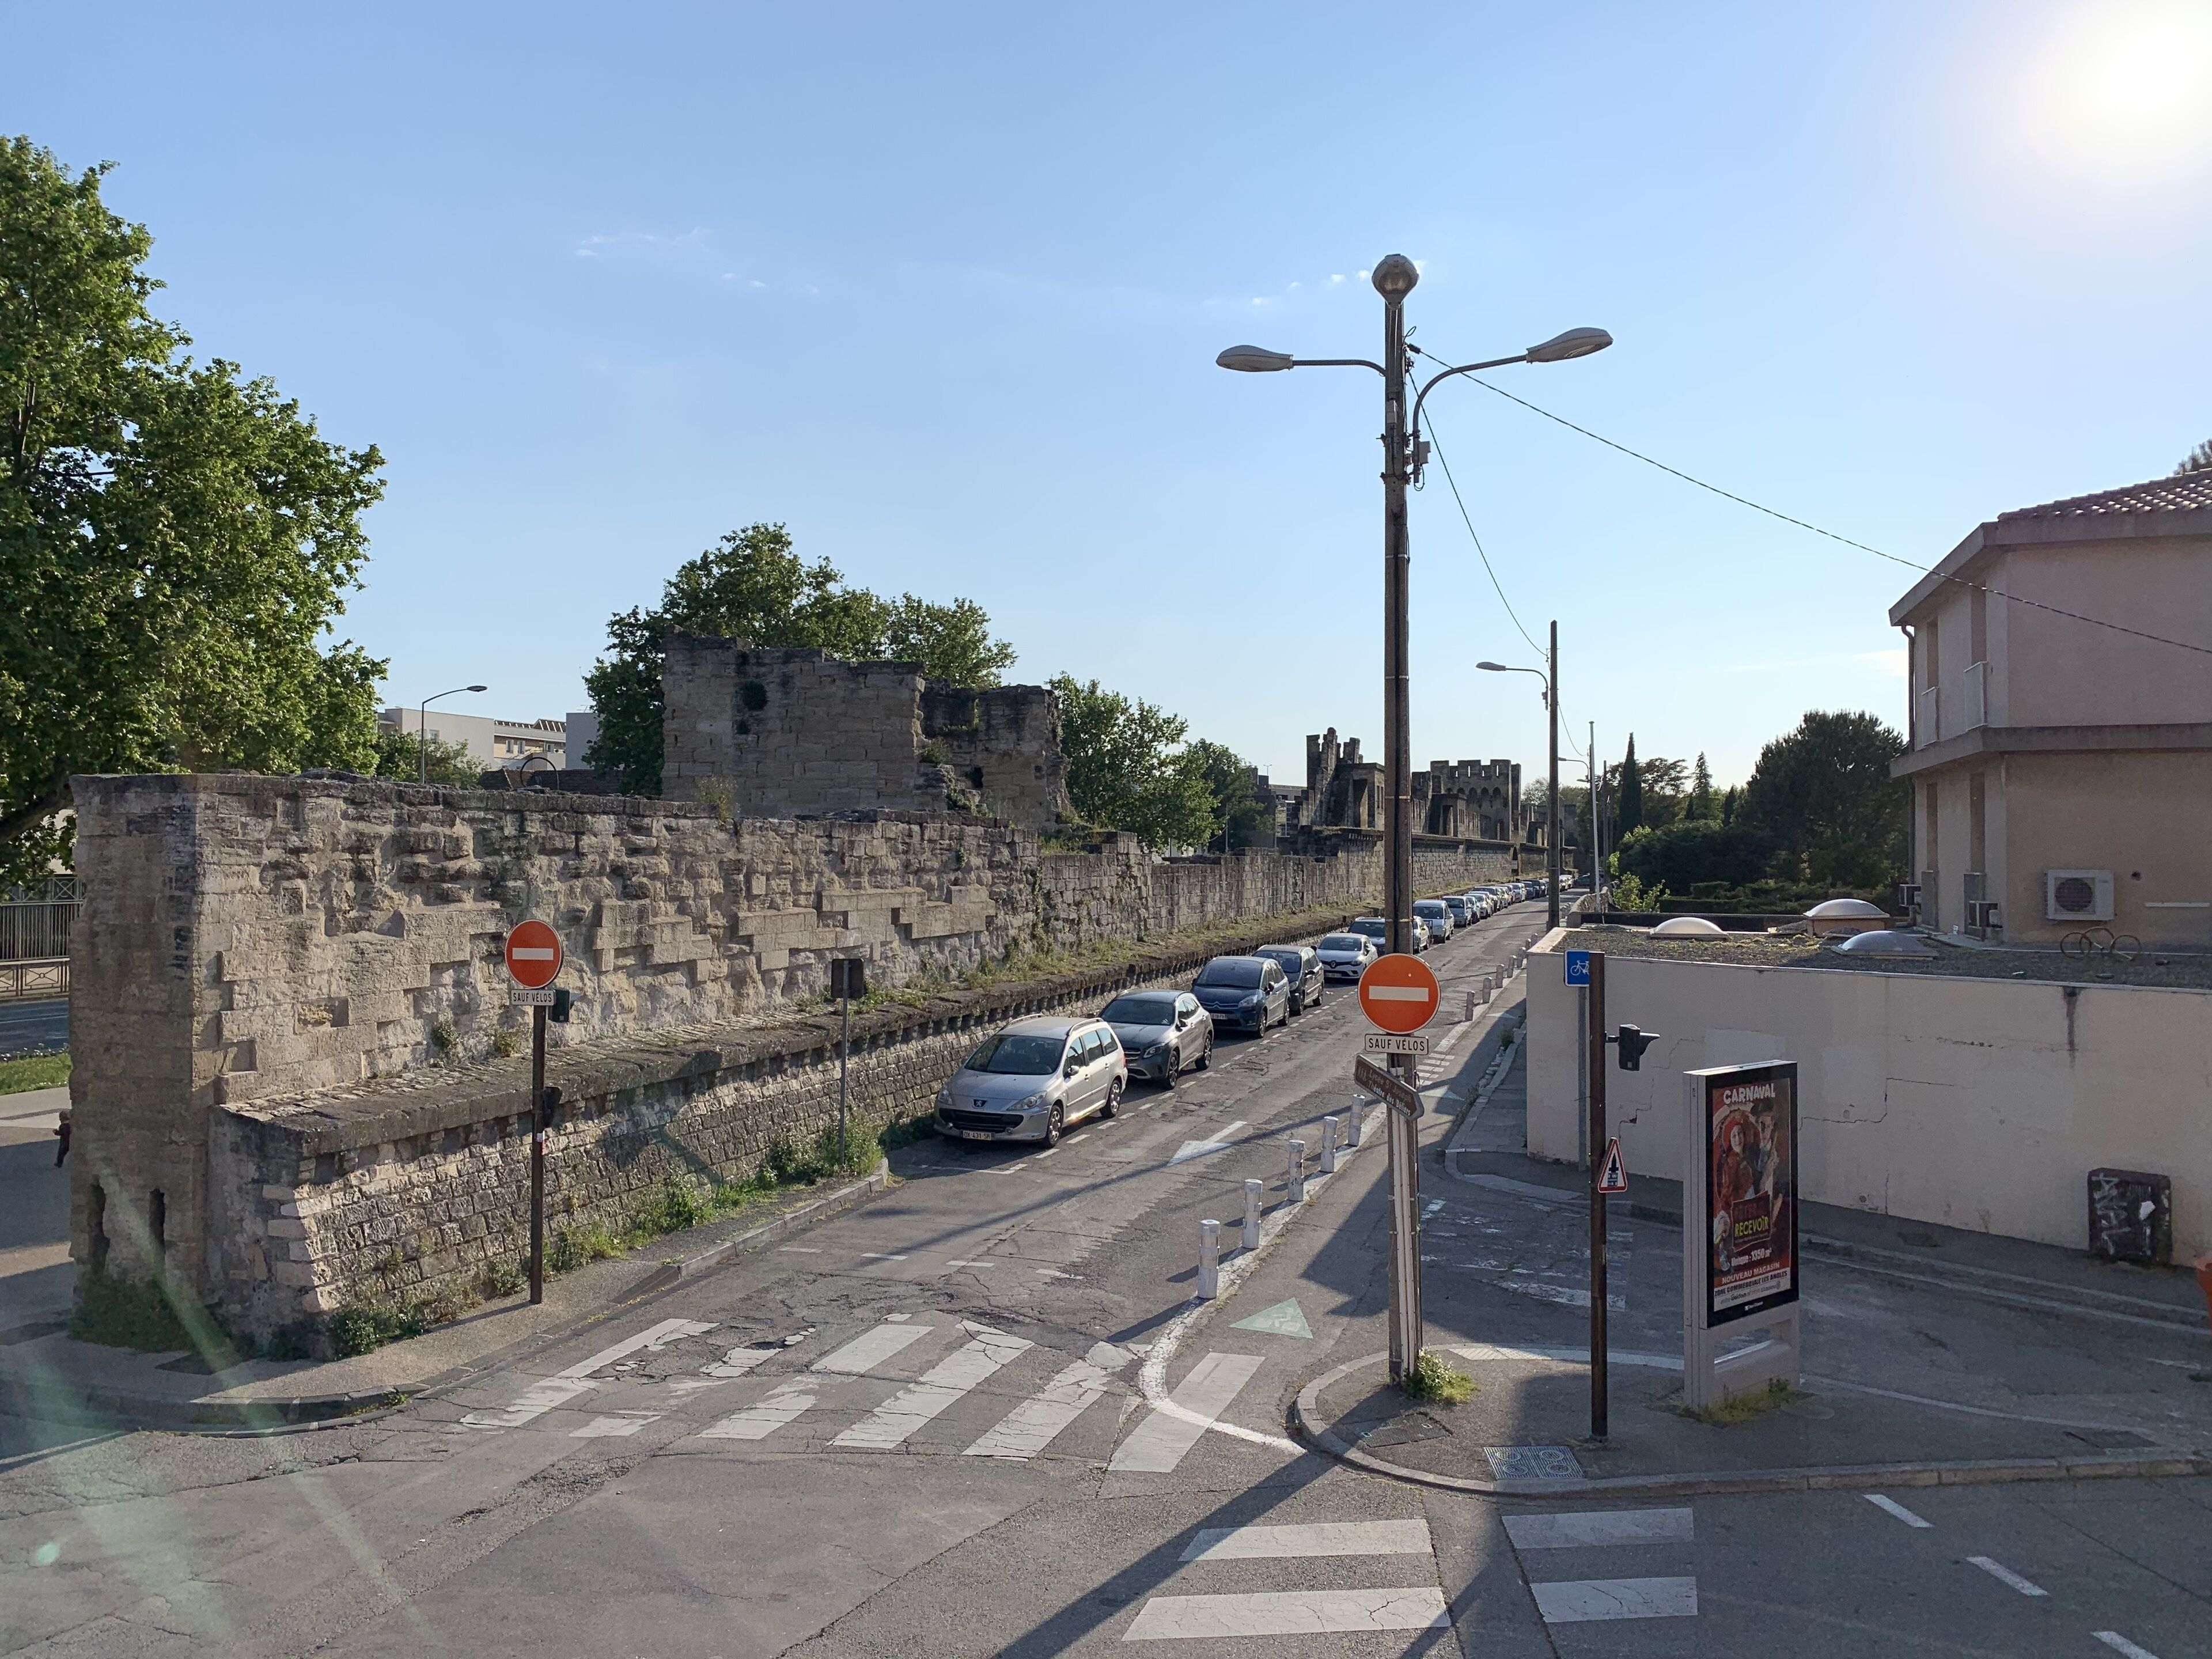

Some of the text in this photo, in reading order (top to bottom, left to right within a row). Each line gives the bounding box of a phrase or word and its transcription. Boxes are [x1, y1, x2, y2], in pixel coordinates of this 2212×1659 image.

[513, 991, 552, 1002] SAUF VÉLOS
[1368, 1037, 1425, 1051] SAUF VÉLOS
[1386, 1093, 1395, 1104] des
[1723, 1083, 1776, 1105] CARNAVAL
[1734, 1215, 1769, 1237] RECEVOIR
[1714, 1287, 1726, 1298] ZONE
[1726, 1278, 1762, 1293] COMMERCIALE
[1761, 1275, 1770, 1284] LES
[1770, 1270, 1788, 1281] ANGLES
[1721, 1261, 1781, 1285] NOUVEAU MAGASIN
